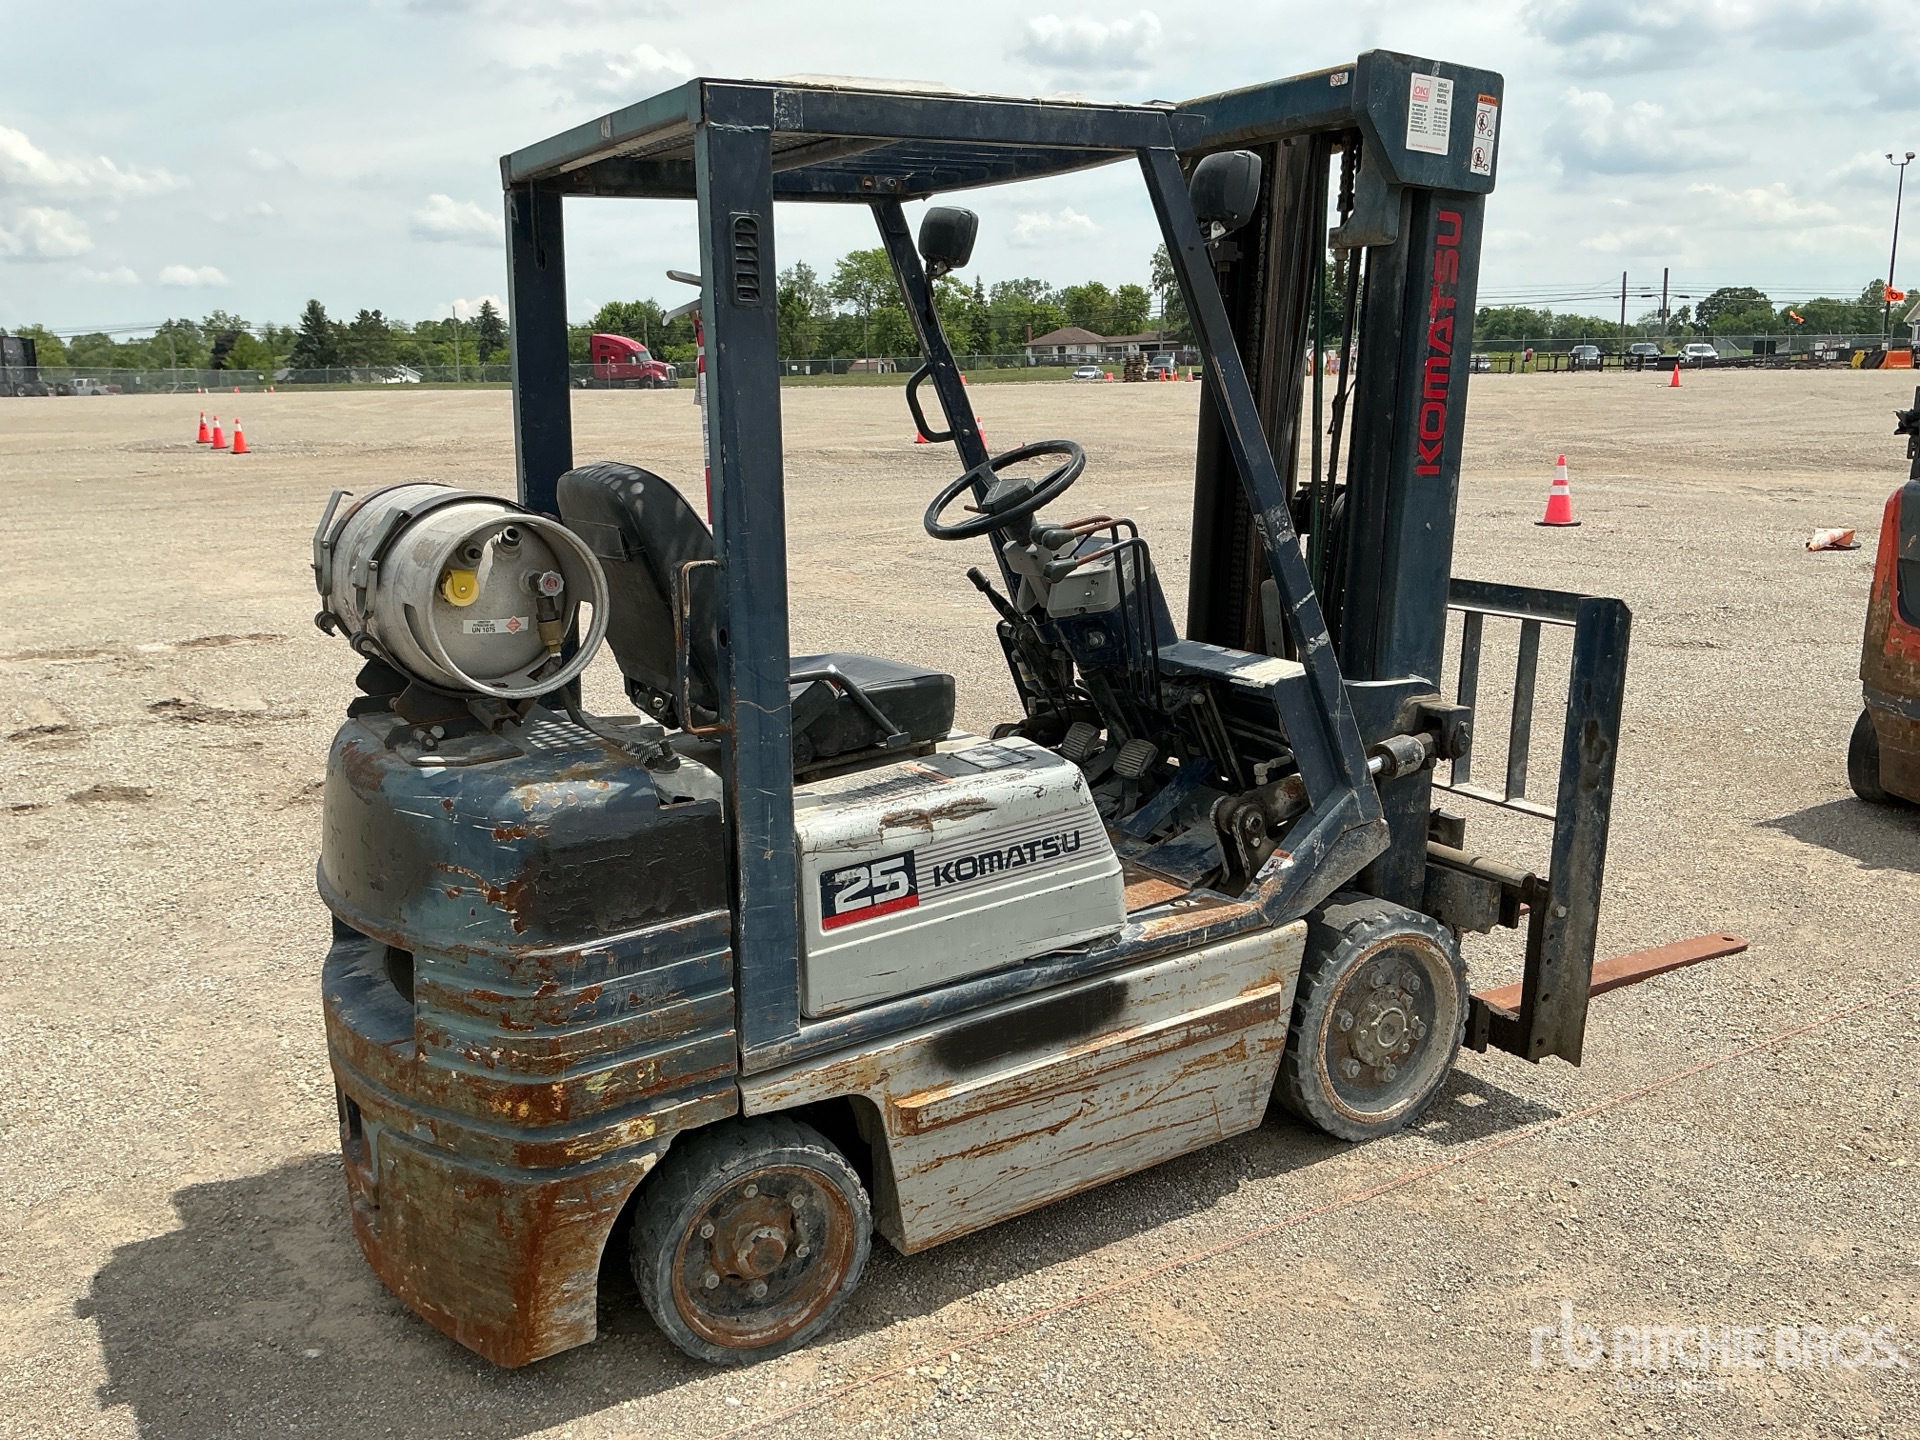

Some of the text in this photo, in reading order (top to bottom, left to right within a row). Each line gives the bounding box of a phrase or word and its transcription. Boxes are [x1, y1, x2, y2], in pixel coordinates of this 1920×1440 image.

[1414, 86, 1429, 96] OKI
[1415, 210, 1463, 475] KOMATSU
[834, 830, 1081, 914] 25 KOMATSU
